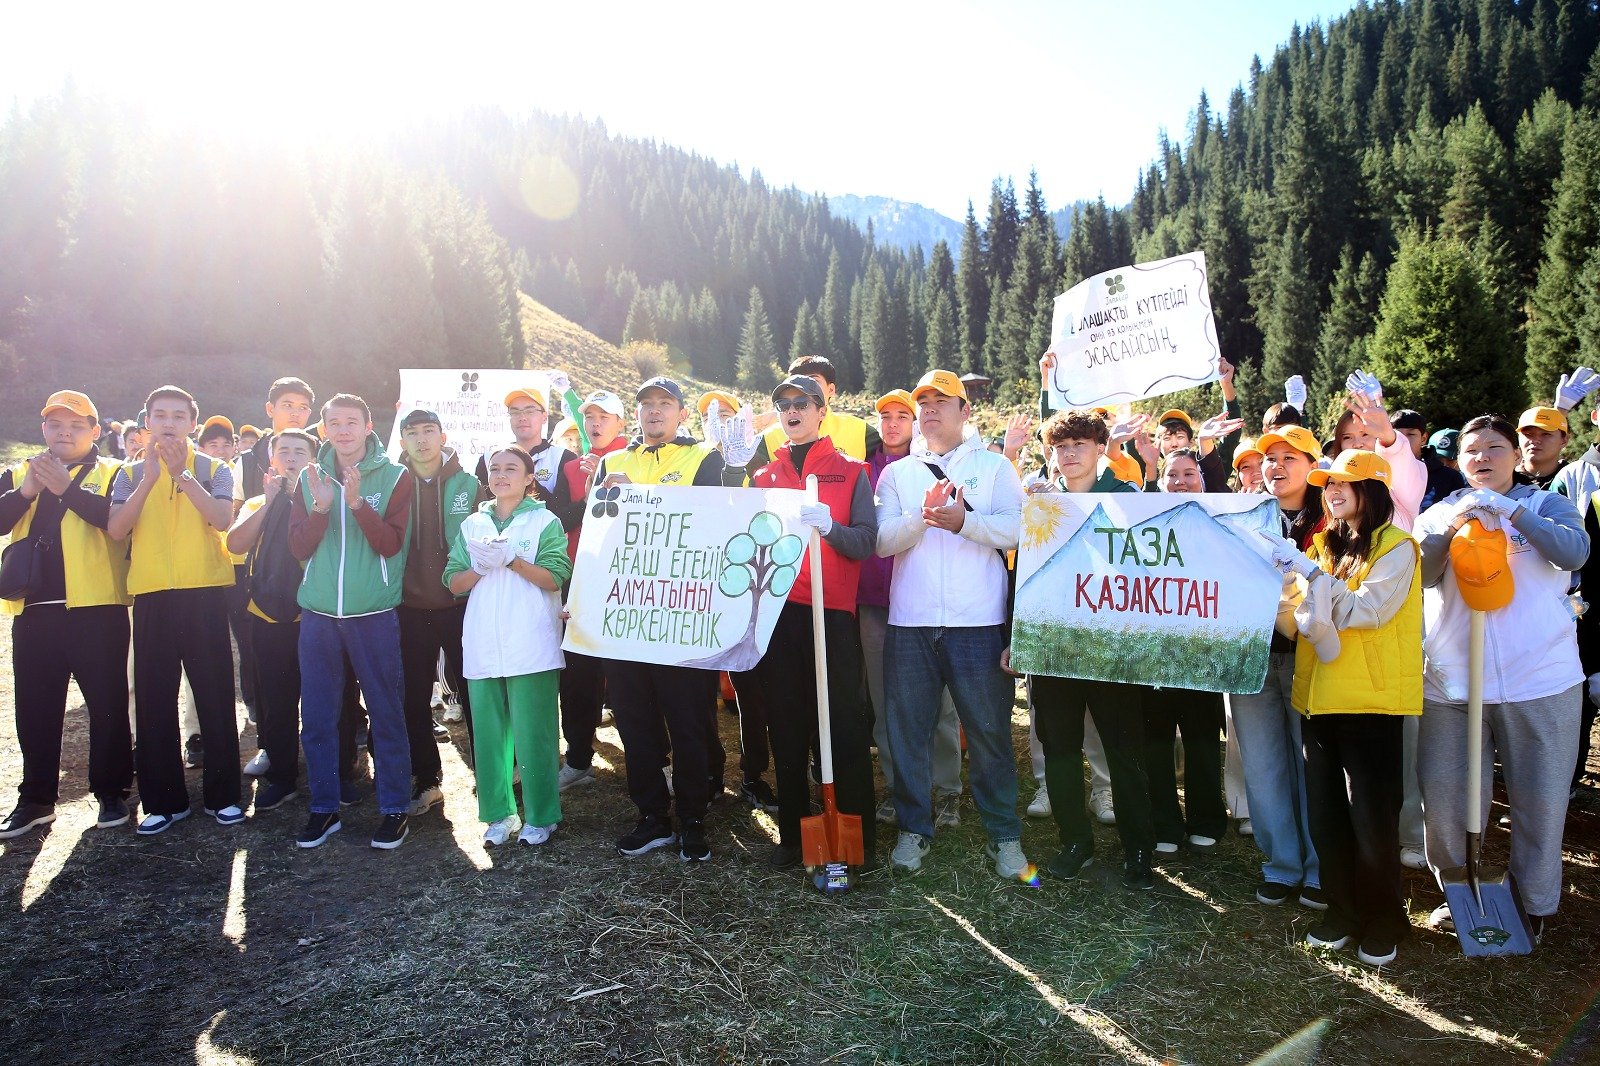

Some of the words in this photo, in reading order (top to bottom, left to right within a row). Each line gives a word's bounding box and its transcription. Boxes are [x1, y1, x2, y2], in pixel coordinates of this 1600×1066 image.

[1085, 327, 1178, 369] ЖАСАЙСЫҢ
[624, 511, 693, 549] БІРГЕ
[1094, 527, 1185, 567] ТАЗА
[608, 546, 660, 578] АҒАШ
[670, 545, 730, 581] ЕГЕЙІК
[606, 578, 714, 612] АЛМАТЫНЫ
[1075, 573, 1219, 619] ҚАЗАҚСТАН
[602, 607, 722, 648] КӨРКЕЙТЕЙІК
